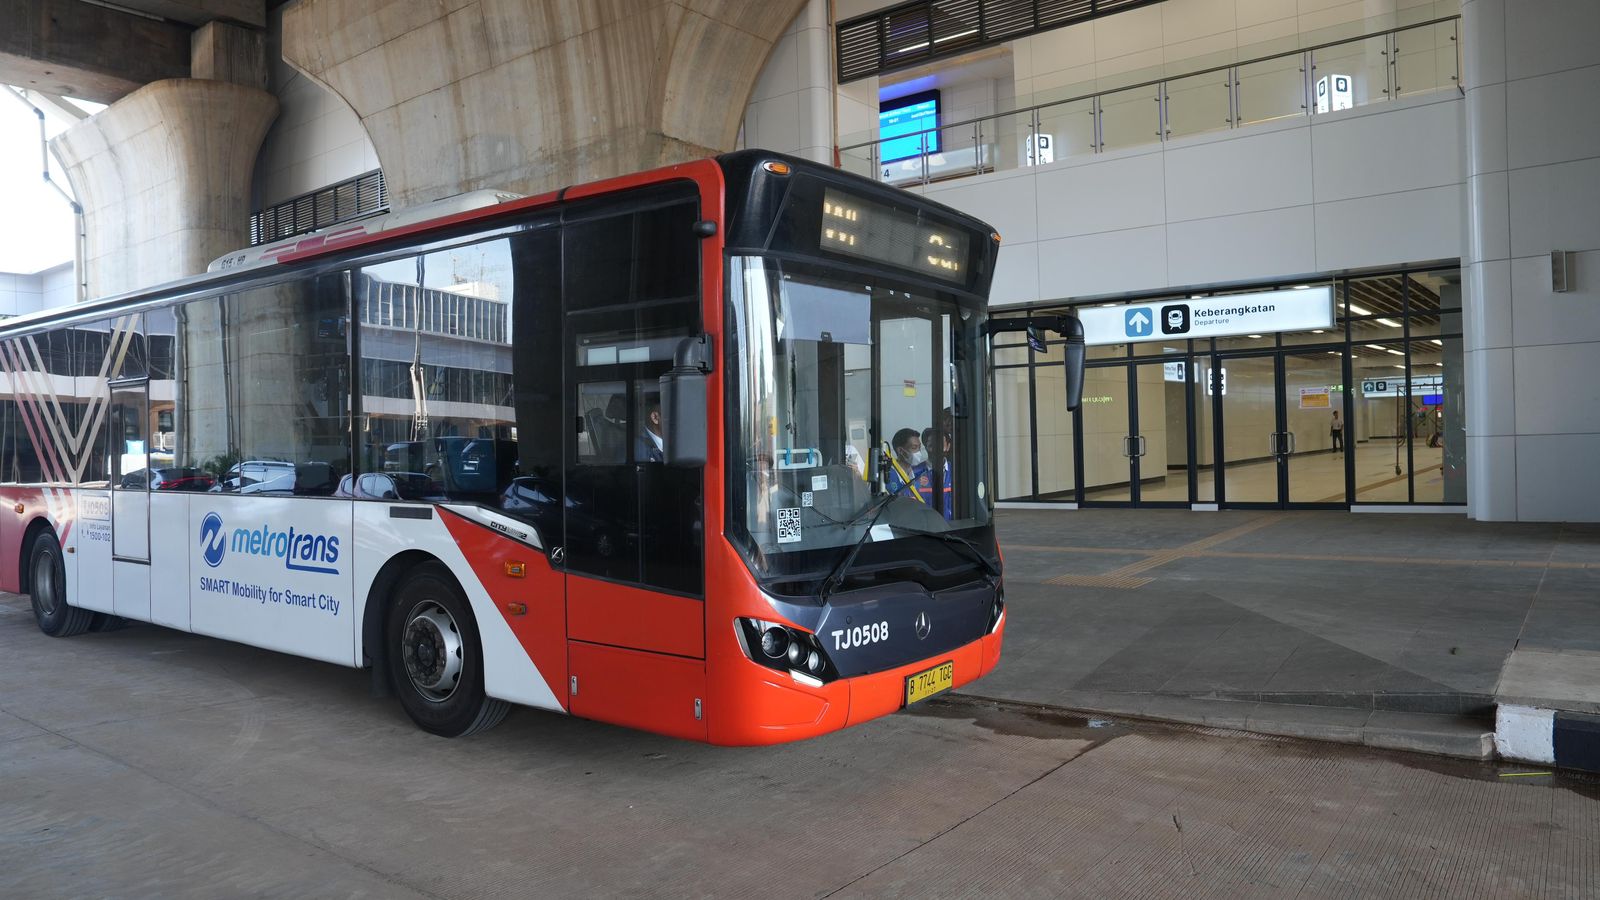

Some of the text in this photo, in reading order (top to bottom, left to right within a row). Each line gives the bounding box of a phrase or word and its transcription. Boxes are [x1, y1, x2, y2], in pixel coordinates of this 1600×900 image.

[883, 168, 890, 178] 4
[1194, 304, 1275, 317] Keberangkatan
[1194, 318, 1230, 326] Departure
[231, 524, 340, 574] metrotrans
[200, 577, 340, 616] SMART Mobility for Smart City
[831, 621, 889, 651] TJ0508
[910, 679, 915, 695] B
[919, 671, 936, 691] 7744
